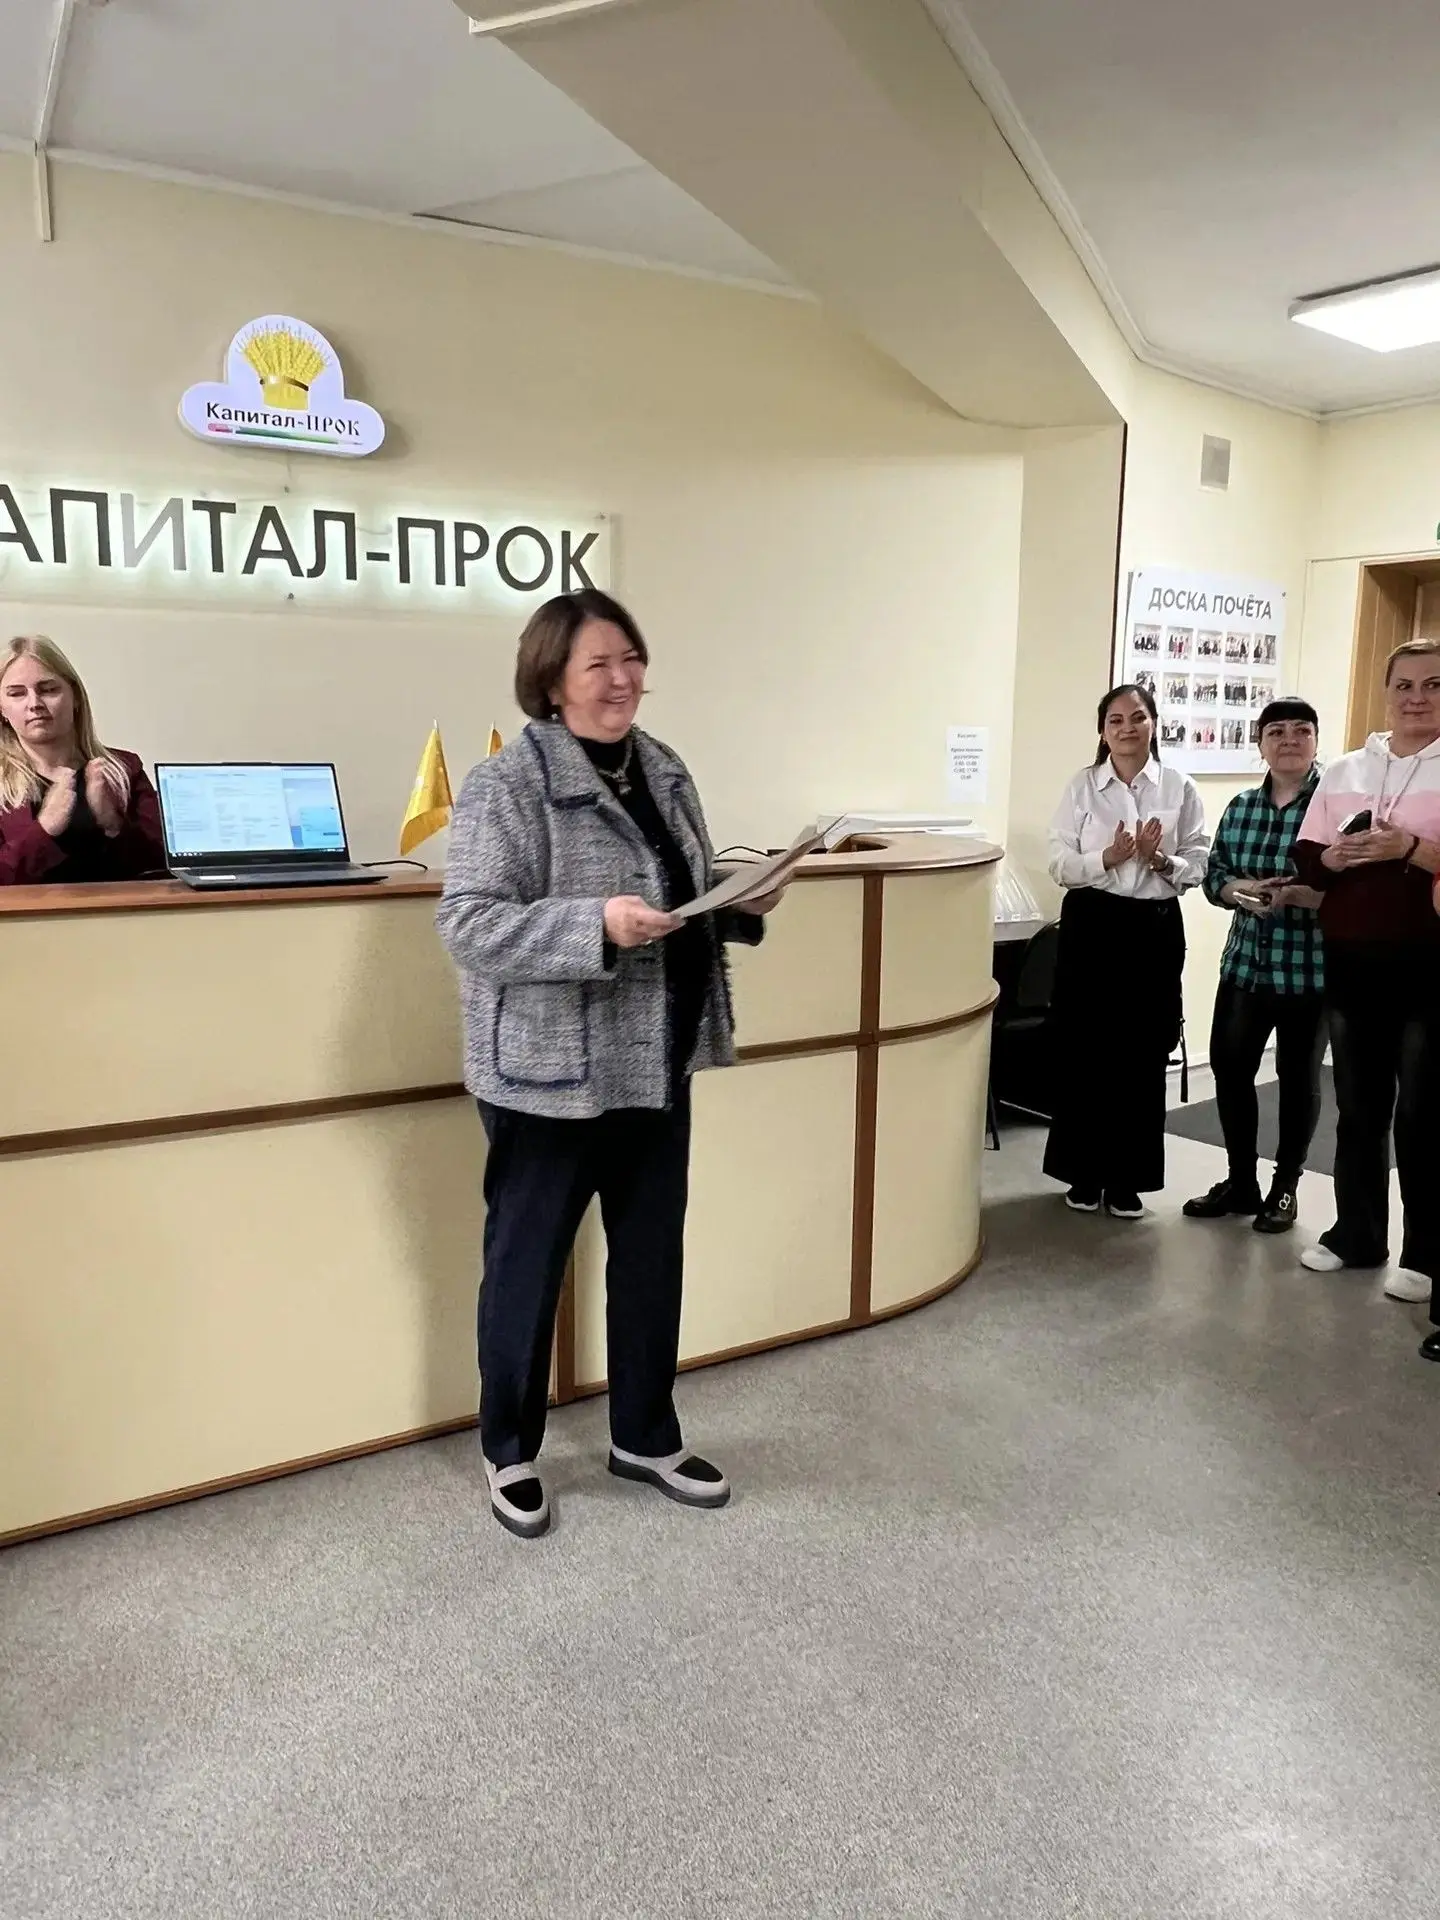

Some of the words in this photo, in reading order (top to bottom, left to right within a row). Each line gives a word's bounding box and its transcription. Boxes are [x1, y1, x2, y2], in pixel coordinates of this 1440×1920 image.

[207, 401, 360, 437] Капитал-ПРОК
[1148, 587, 1207, 612] ДОСКА
[1212, 594, 1272, 619] ПОЧЁТА
